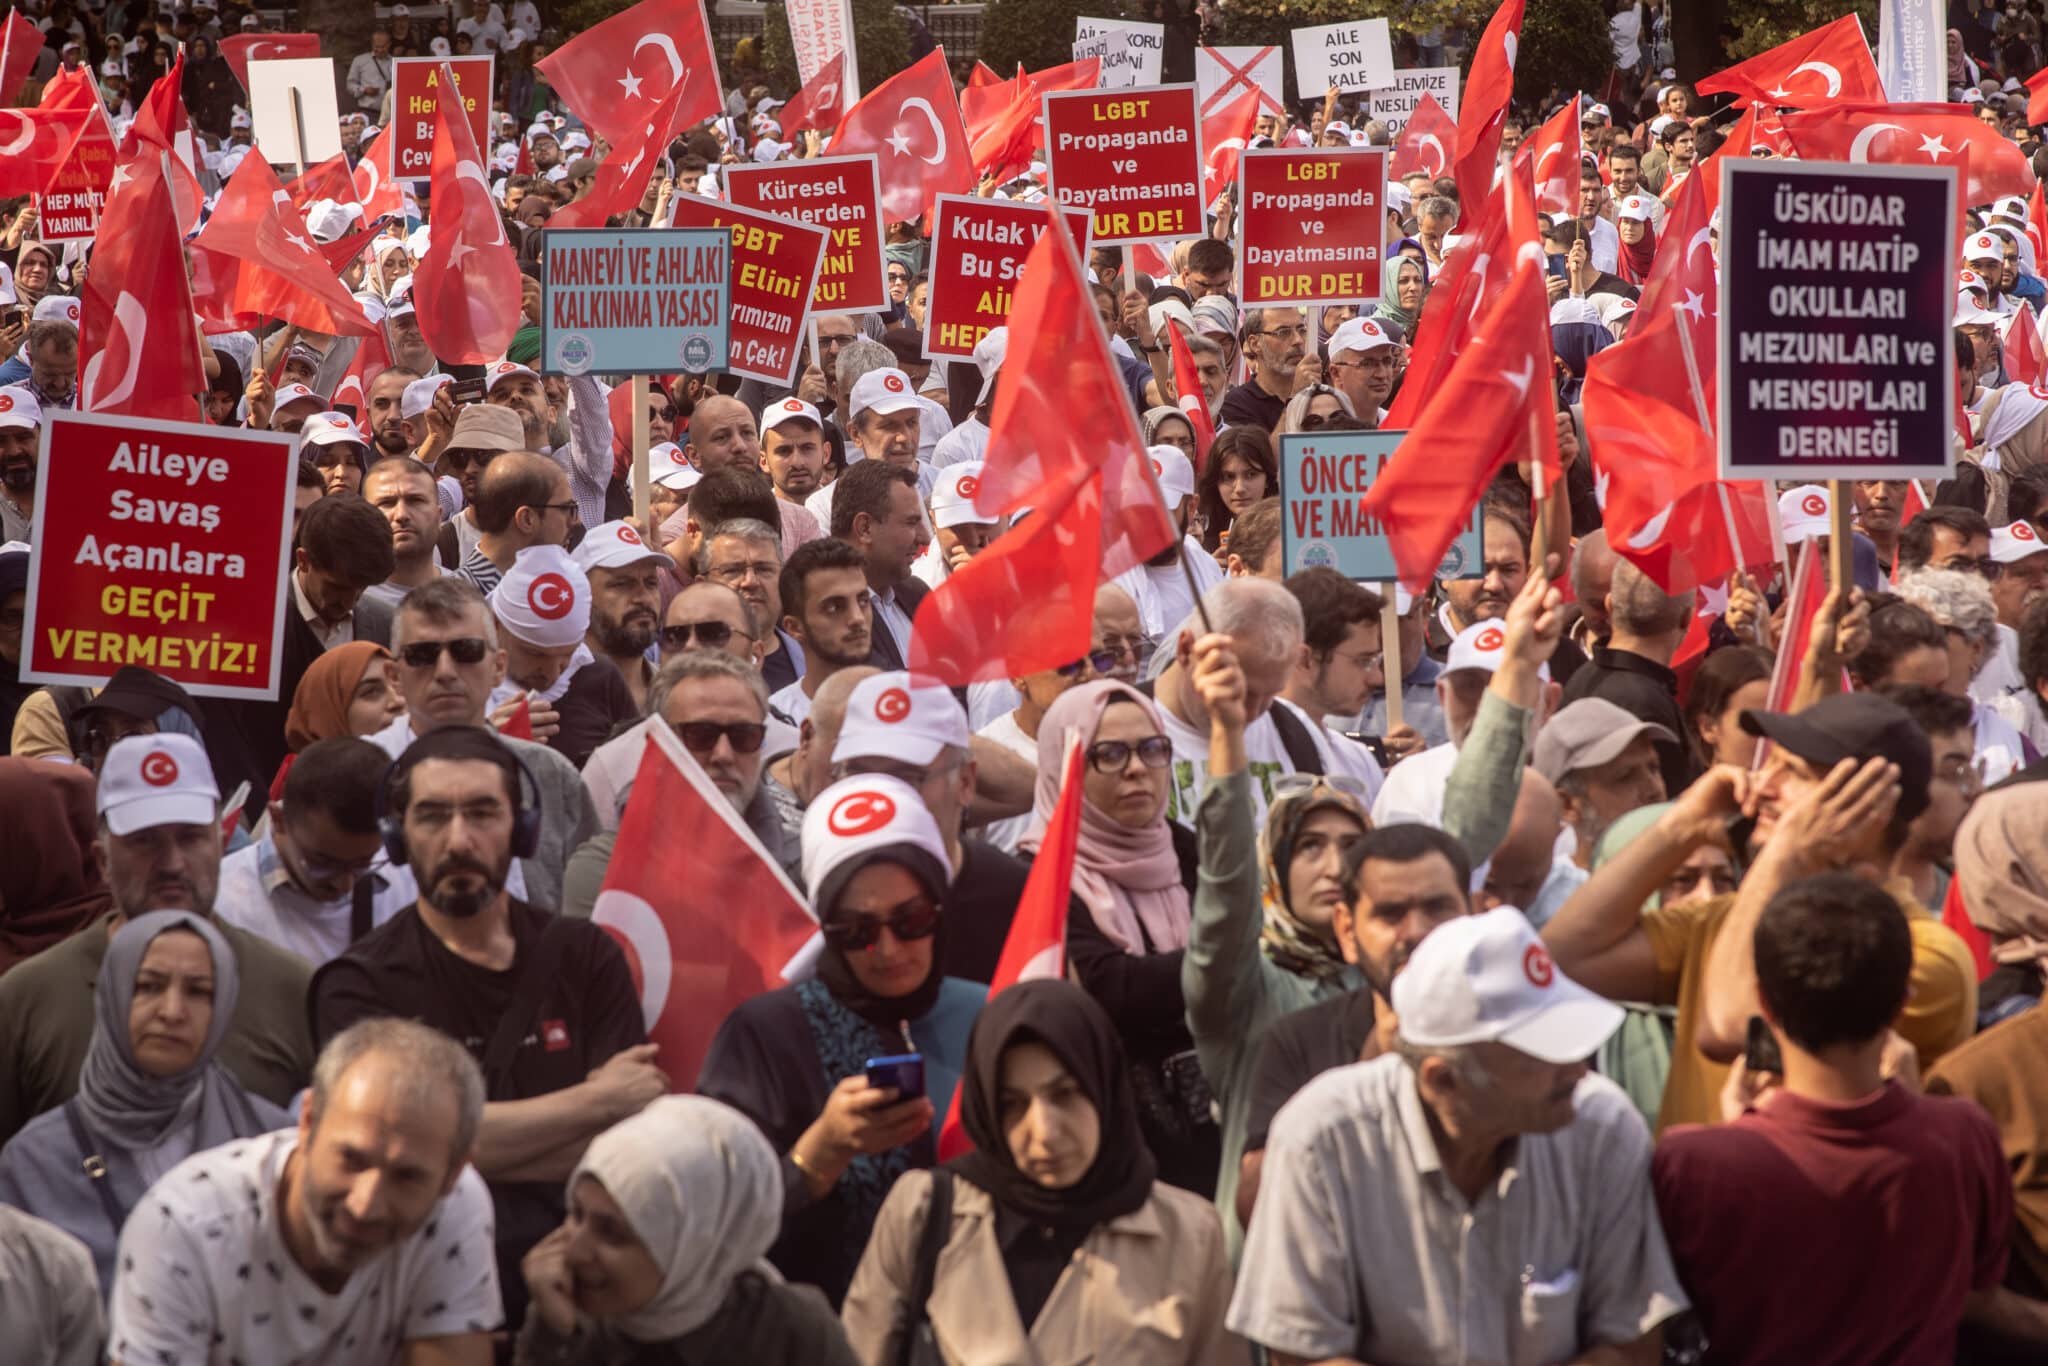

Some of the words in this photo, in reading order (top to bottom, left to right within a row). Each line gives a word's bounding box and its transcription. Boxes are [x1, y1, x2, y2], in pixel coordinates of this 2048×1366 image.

[1325, 28, 1360, 48] AİLE
[1329, 50, 1362, 67] SON
[1328, 70, 1368, 88] KALE
[1092, 100, 1150, 121] LGBT
[1058, 125, 1188, 152] Propaganda
[1112, 159, 1138, 174] ve
[1287, 162, 1341, 181] LGBT
[46, 193, 71, 211] HEP
[758, 176, 847, 201] Küresel
[1057, 182, 1196, 207] Dayatmasına
[1252, 188, 1375, 212] Propaganda
[1774, 183, 1906, 227] ÜSKÜDAR
[952, 215, 1025, 246] Kulak
[1138, 209, 1184, 233] DE!
[1300, 220, 1325, 235] ve
[713, 218, 783, 256] GBT
[832, 228, 862, 248] VE
[1757, 229, 1833, 271] İMAM
[1839, 235, 1920, 273] HATİP
[549, 238, 624, 287] MANEVİ
[628, 248, 652, 285] VE
[655, 237, 724, 285] AHLAKİ
[961, 252, 993, 278] Bu
[1247, 246, 1377, 267] Dayatmasına
[739, 262, 802, 299] Elini
[1259, 275, 1312, 298] DUR
[1320, 273, 1364, 296] DE!
[553, 290, 653, 329] KALKINMA
[656, 289, 719, 328] YASASI
[1769, 285, 1907, 320] OKULLARI
[745, 339, 786, 370] Çek!
[1739, 332, 1899, 366] MEZUNLARI
[1903, 341, 1936, 366] ve
[1749, 379, 1926, 412] MENSUPLARI
[1779, 419, 1899, 458] DERNEĞİ
[107, 441, 230, 487] Aileye
[1300, 447, 1368, 495] ÖNCE
[108, 489, 222, 533] Savaş
[1291, 499, 1324, 539] VE
[74, 534, 246, 580] Açanlara
[101, 582, 216, 625] GEÇİT
[47, 627, 258, 675] VERMEYİZ!
